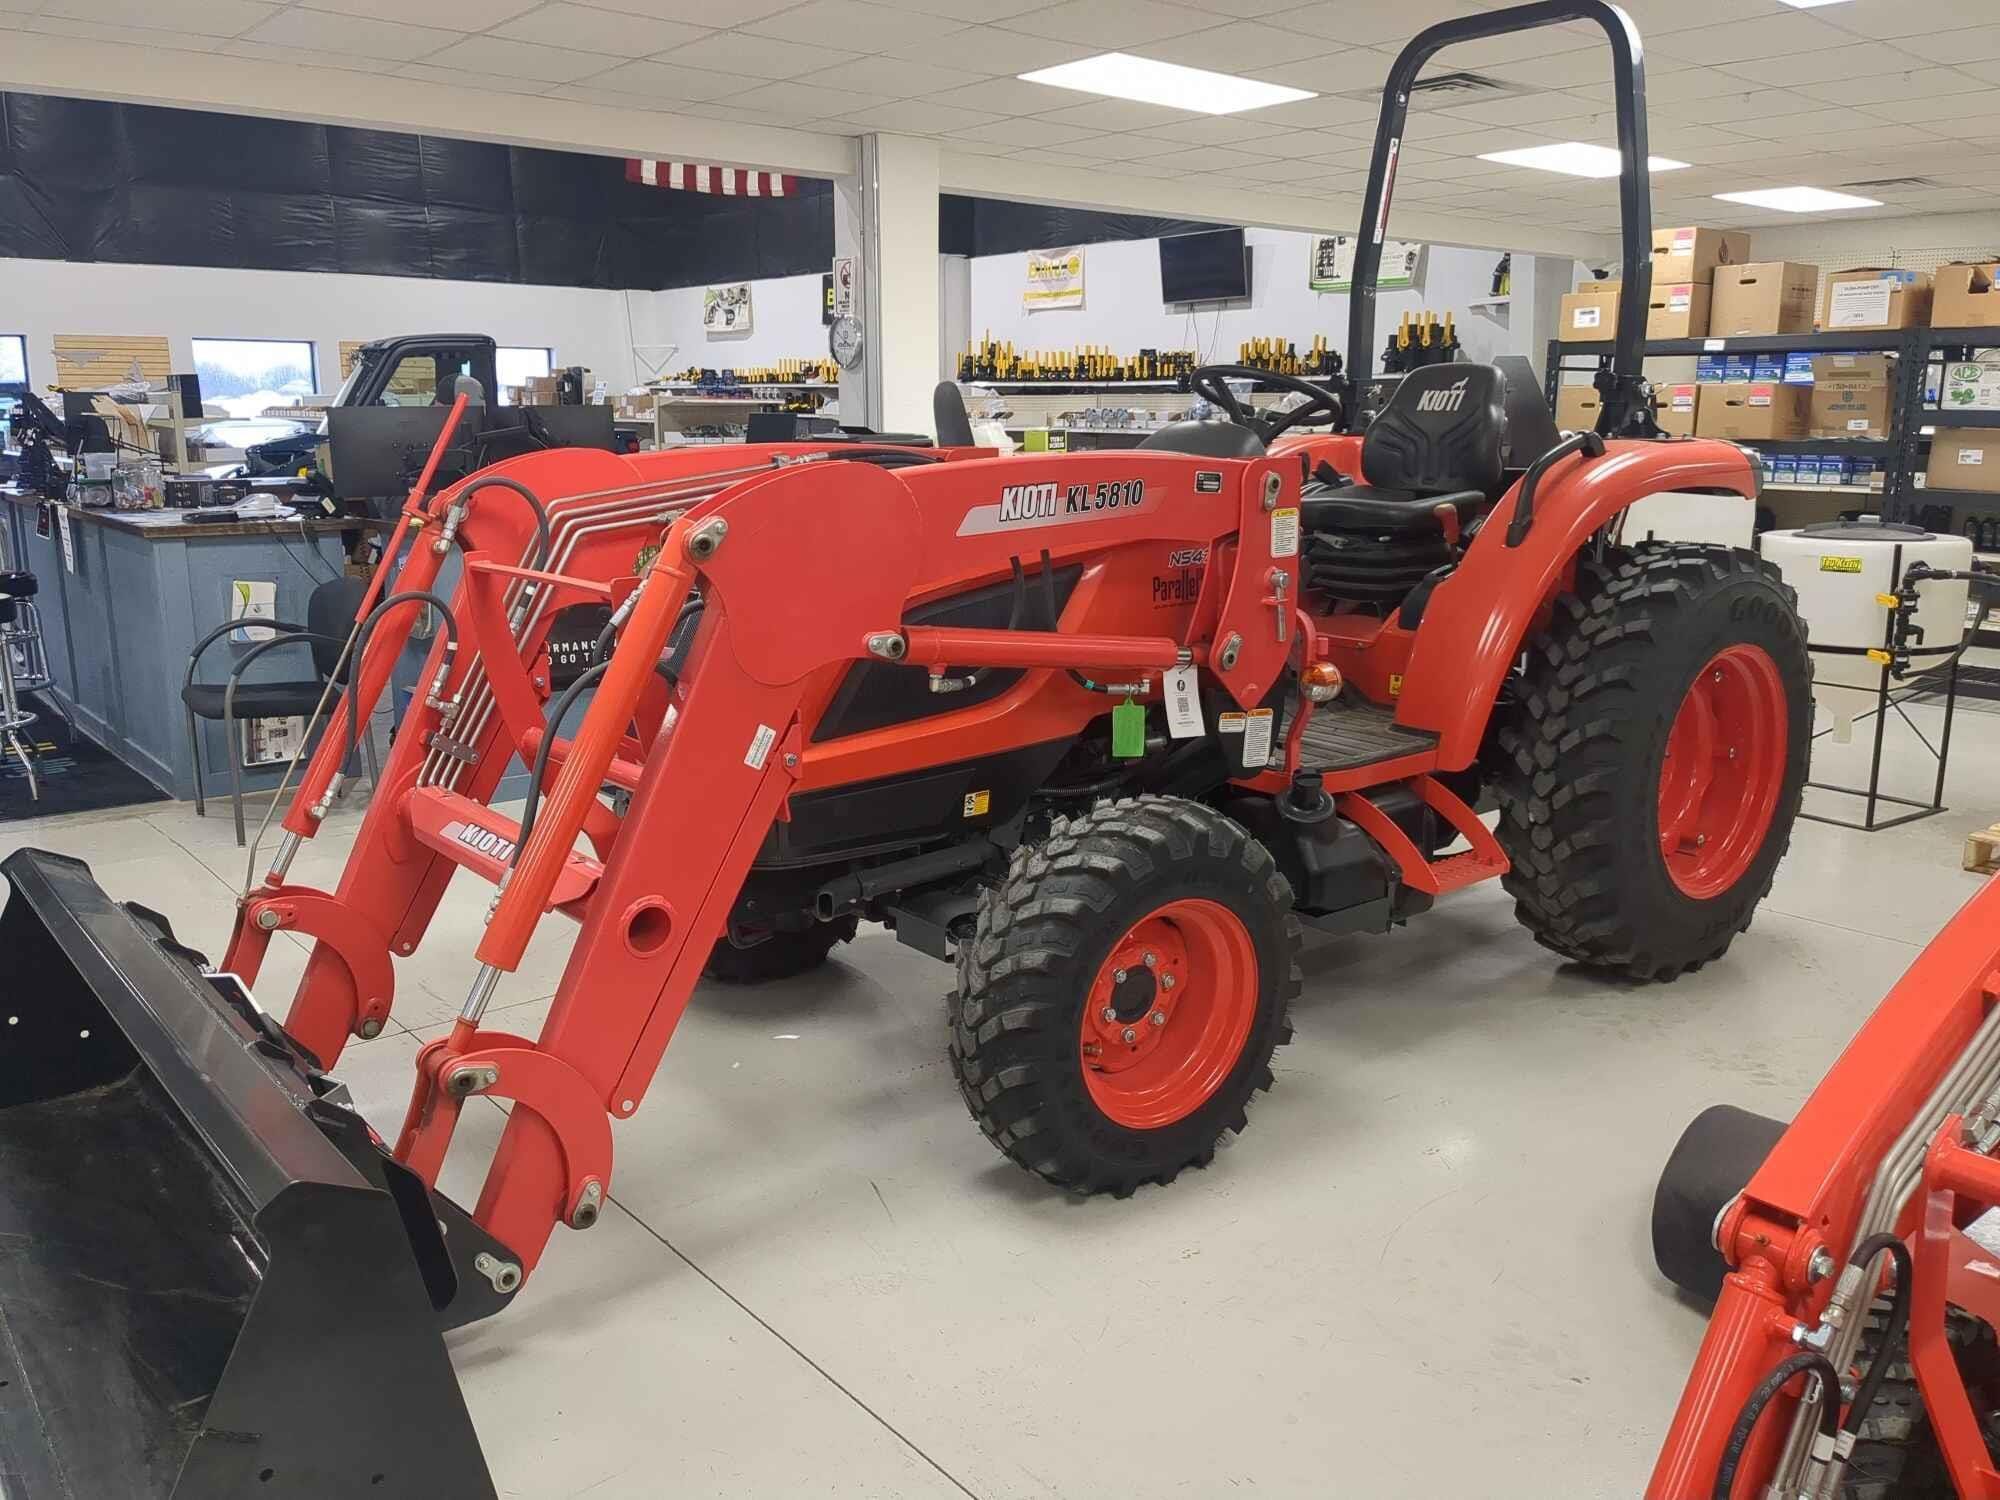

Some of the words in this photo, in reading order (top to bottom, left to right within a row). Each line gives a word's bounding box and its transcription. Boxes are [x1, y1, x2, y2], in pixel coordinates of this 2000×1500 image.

[1416, 382, 1468, 411] KIOTI
[999, 481, 1059, 522] KIOTI
[1065, 486, 1091, 514] KL
[1095, 479, 1145, 510] 5810
[457, 822, 517, 862] KIOTI
